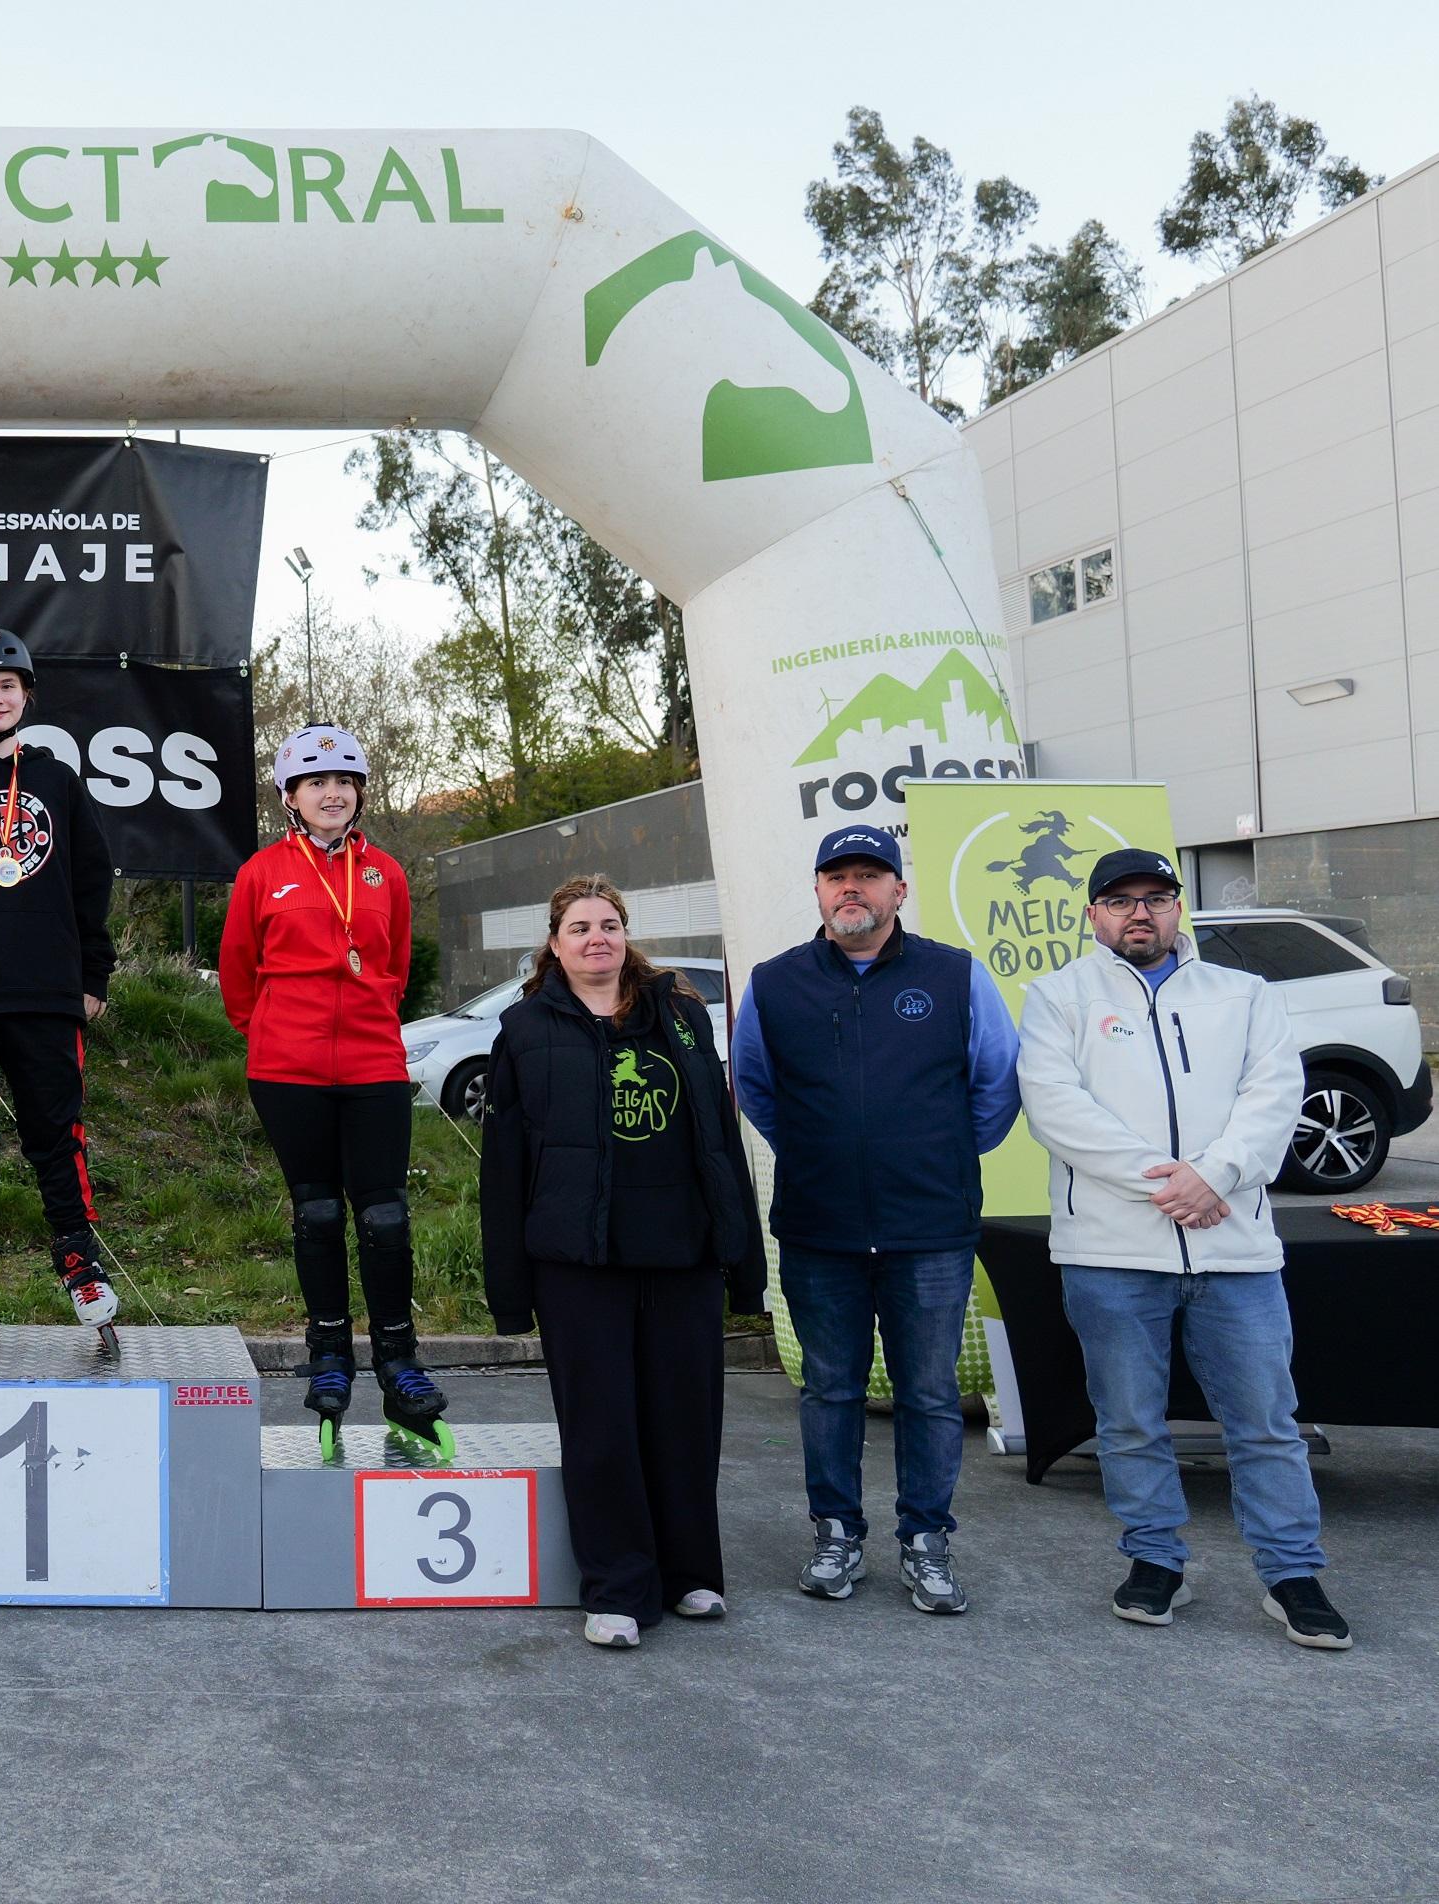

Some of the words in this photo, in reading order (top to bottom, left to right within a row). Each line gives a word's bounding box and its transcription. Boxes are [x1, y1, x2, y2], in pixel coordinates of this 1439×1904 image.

[112, 513, 141, 531] DE
[177, 1385, 250, 1398] SOFTEE
[415, 1491, 478, 1585] 3
